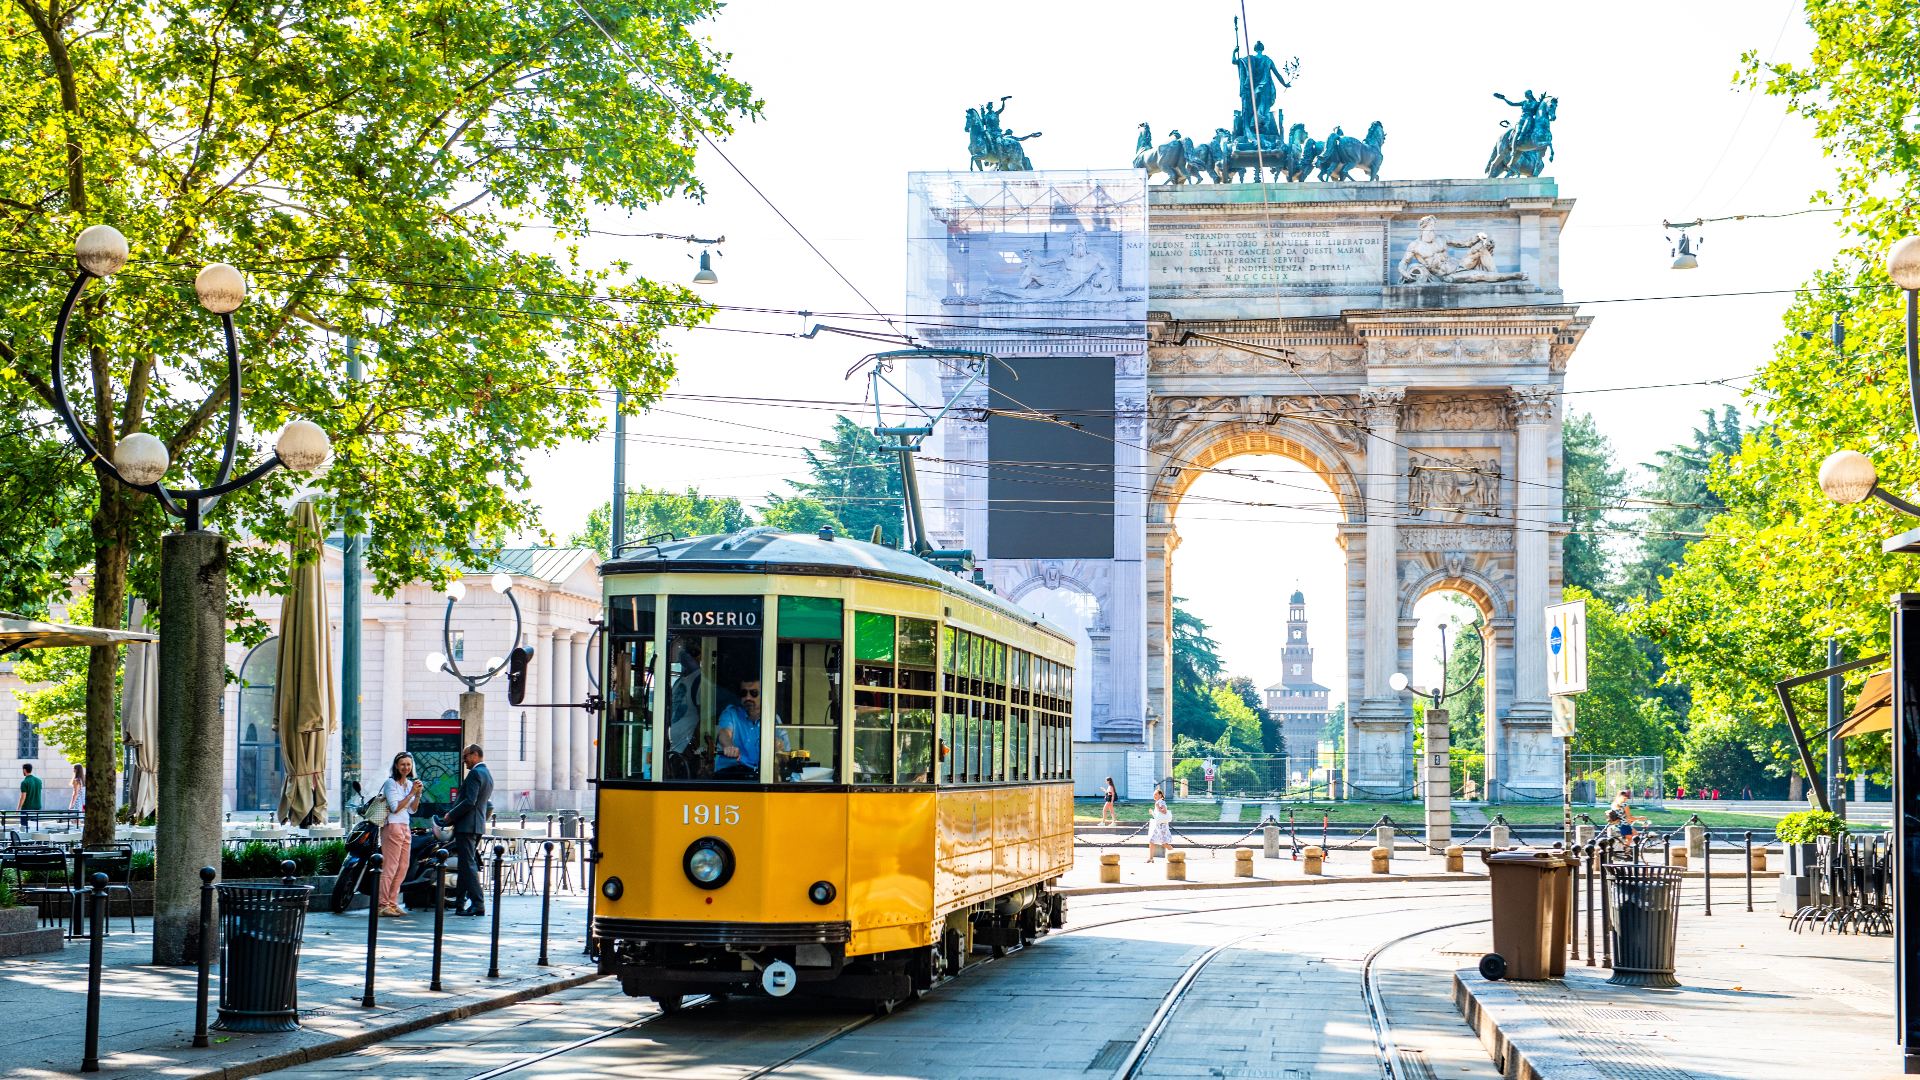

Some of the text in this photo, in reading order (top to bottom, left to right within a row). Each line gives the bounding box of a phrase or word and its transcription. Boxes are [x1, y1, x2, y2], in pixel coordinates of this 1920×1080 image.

[1185, 232, 1230, 240] ENTRANDO
[1264, 231, 1284, 239] ARMI
[1217, 240, 1258, 248] VITTORIO
[1328, 238, 1380, 246] LIBERATORI
[1189, 249, 1234, 257] ESULTANTE
[1302, 247, 1332, 255] QUESTI
[1208, 257, 1218, 265] LE
[1273, 256, 1305, 264] SERVILI
[1162, 266, 1167, 274] E
[1174, 266, 1183, 274] VI
[1238, 264, 1303, 272] INDIPENDENZA
[681, 611, 756, 626] ROSERIO
[683, 804, 740, 825] 1915
